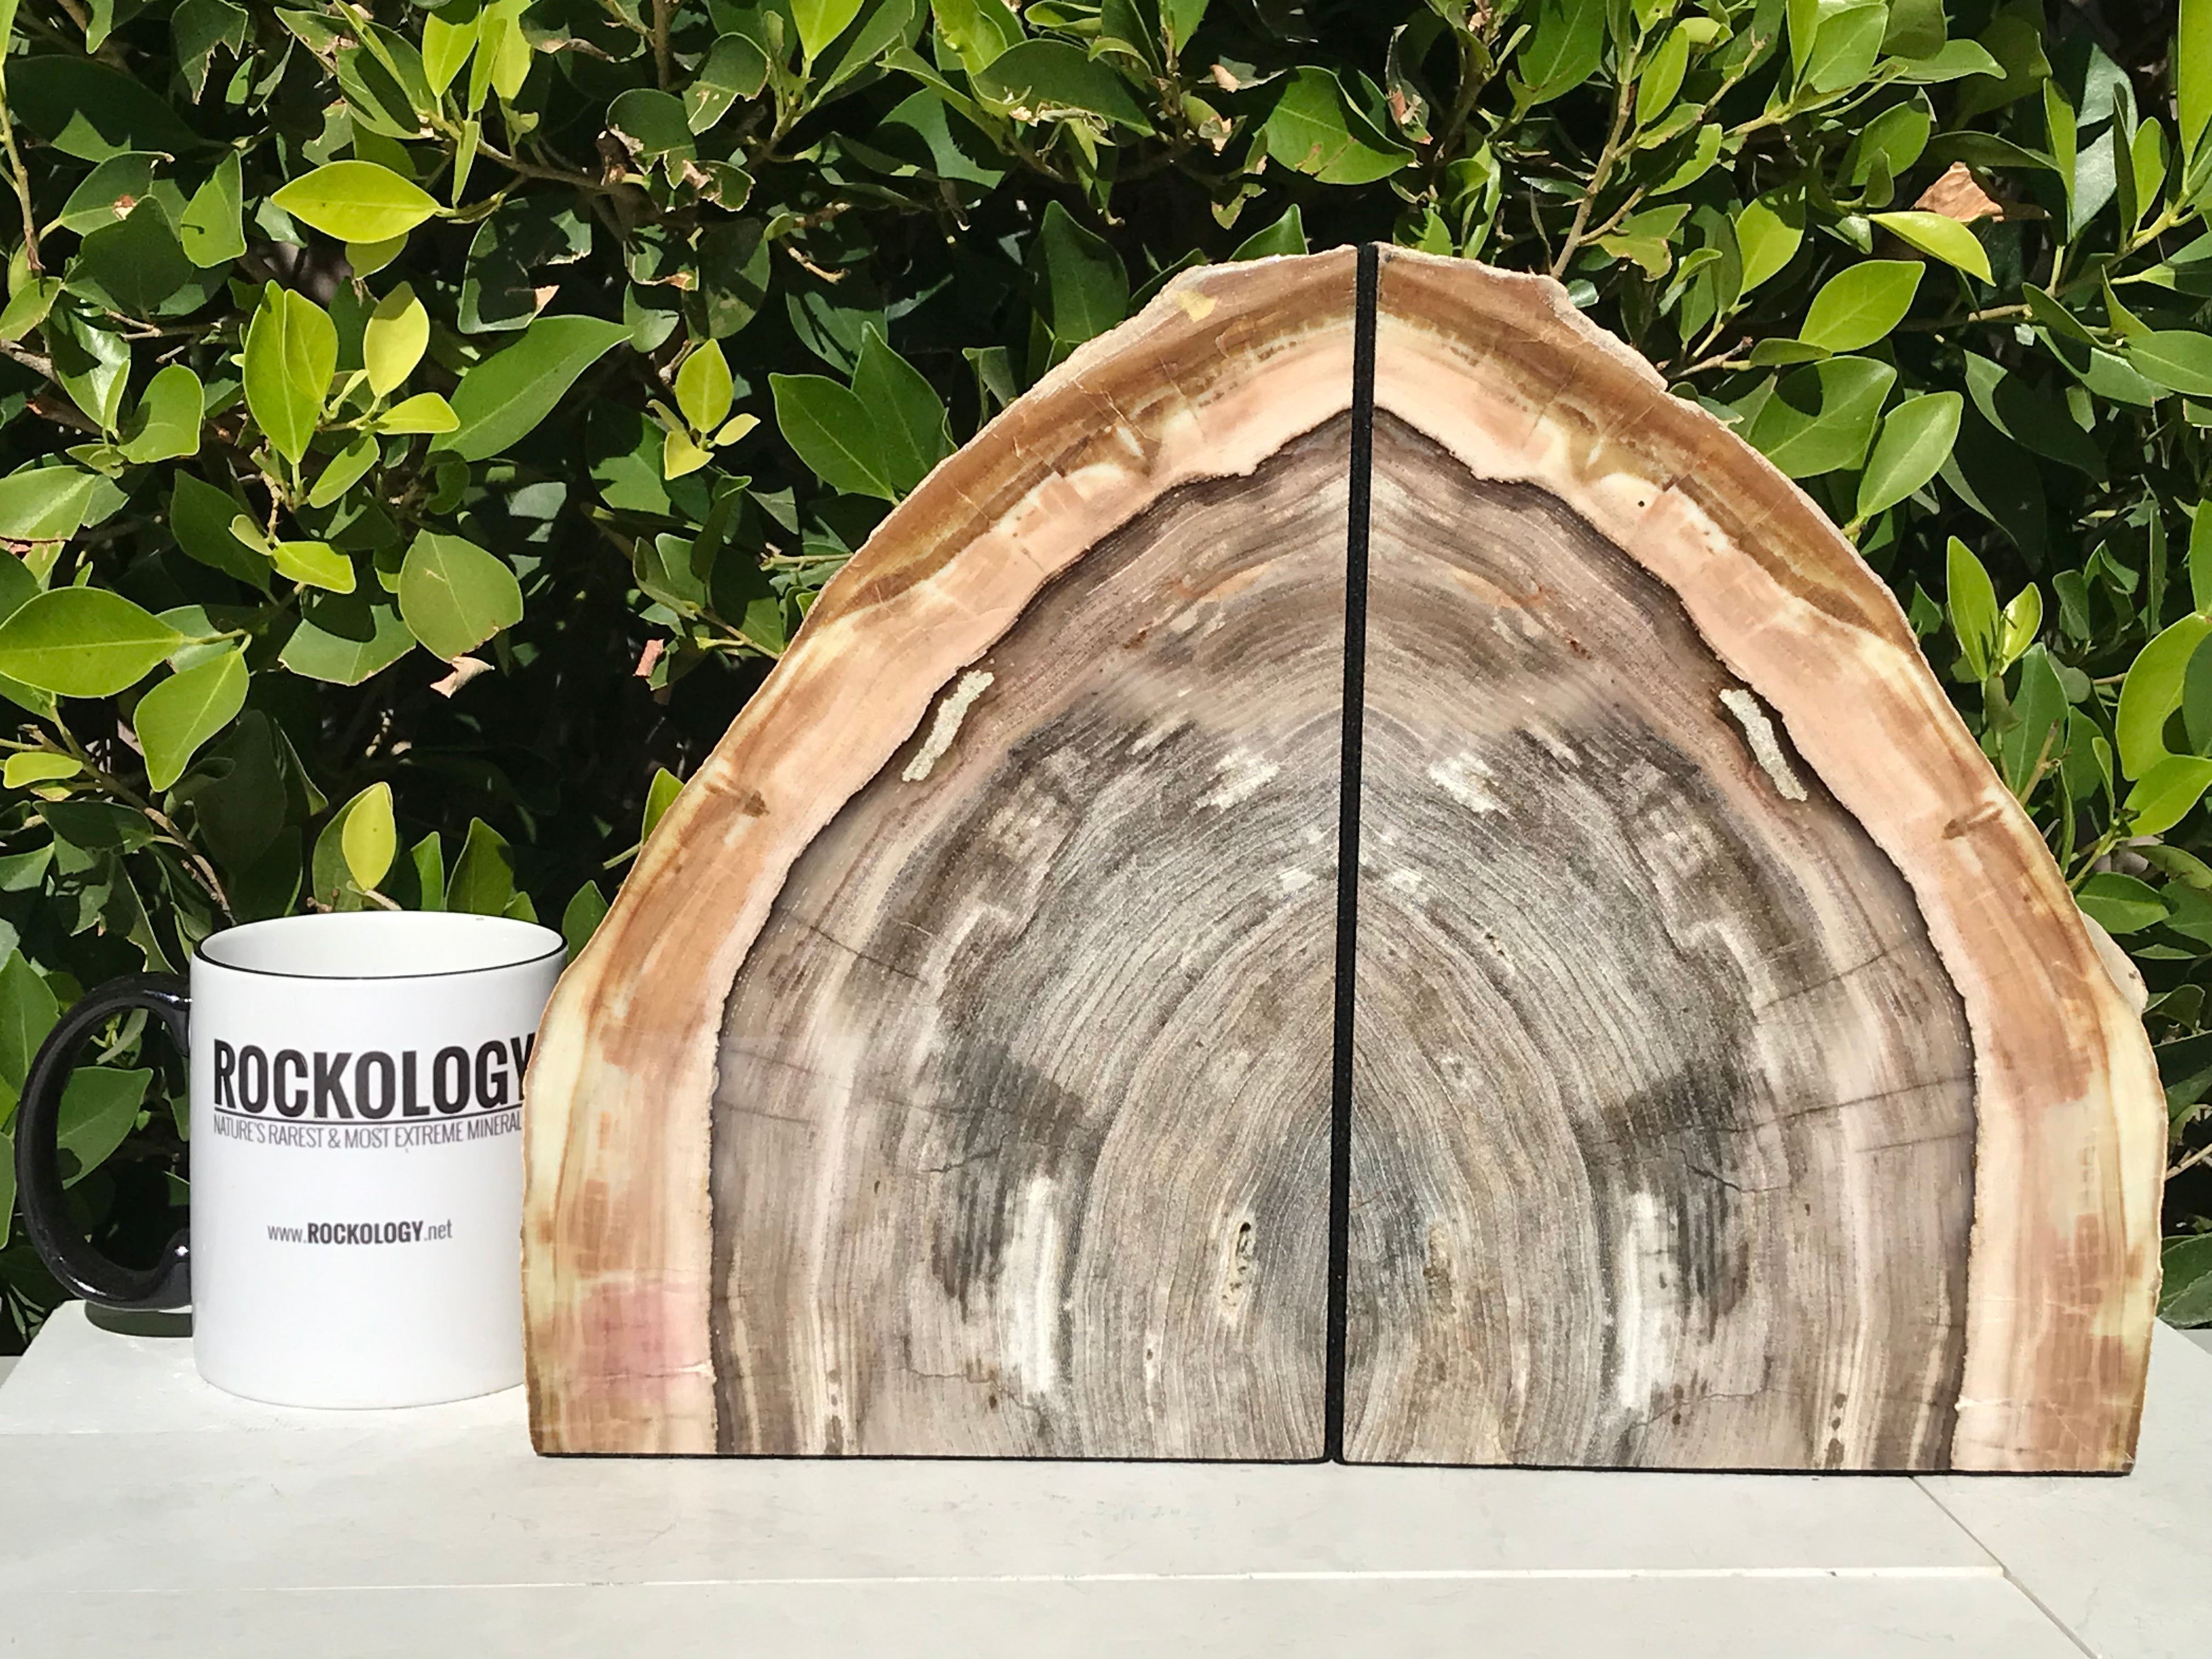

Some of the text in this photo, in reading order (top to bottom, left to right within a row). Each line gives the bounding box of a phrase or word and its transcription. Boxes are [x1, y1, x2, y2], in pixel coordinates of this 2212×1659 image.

[214, 1032, 535, 1119] ROCKOLOGY
[214, 1110, 522, 1149] NATURE'S RAREST & MOST EXTREME MINERAL
[267, 1218, 453, 1245] www.ROCKOLOGY.net
